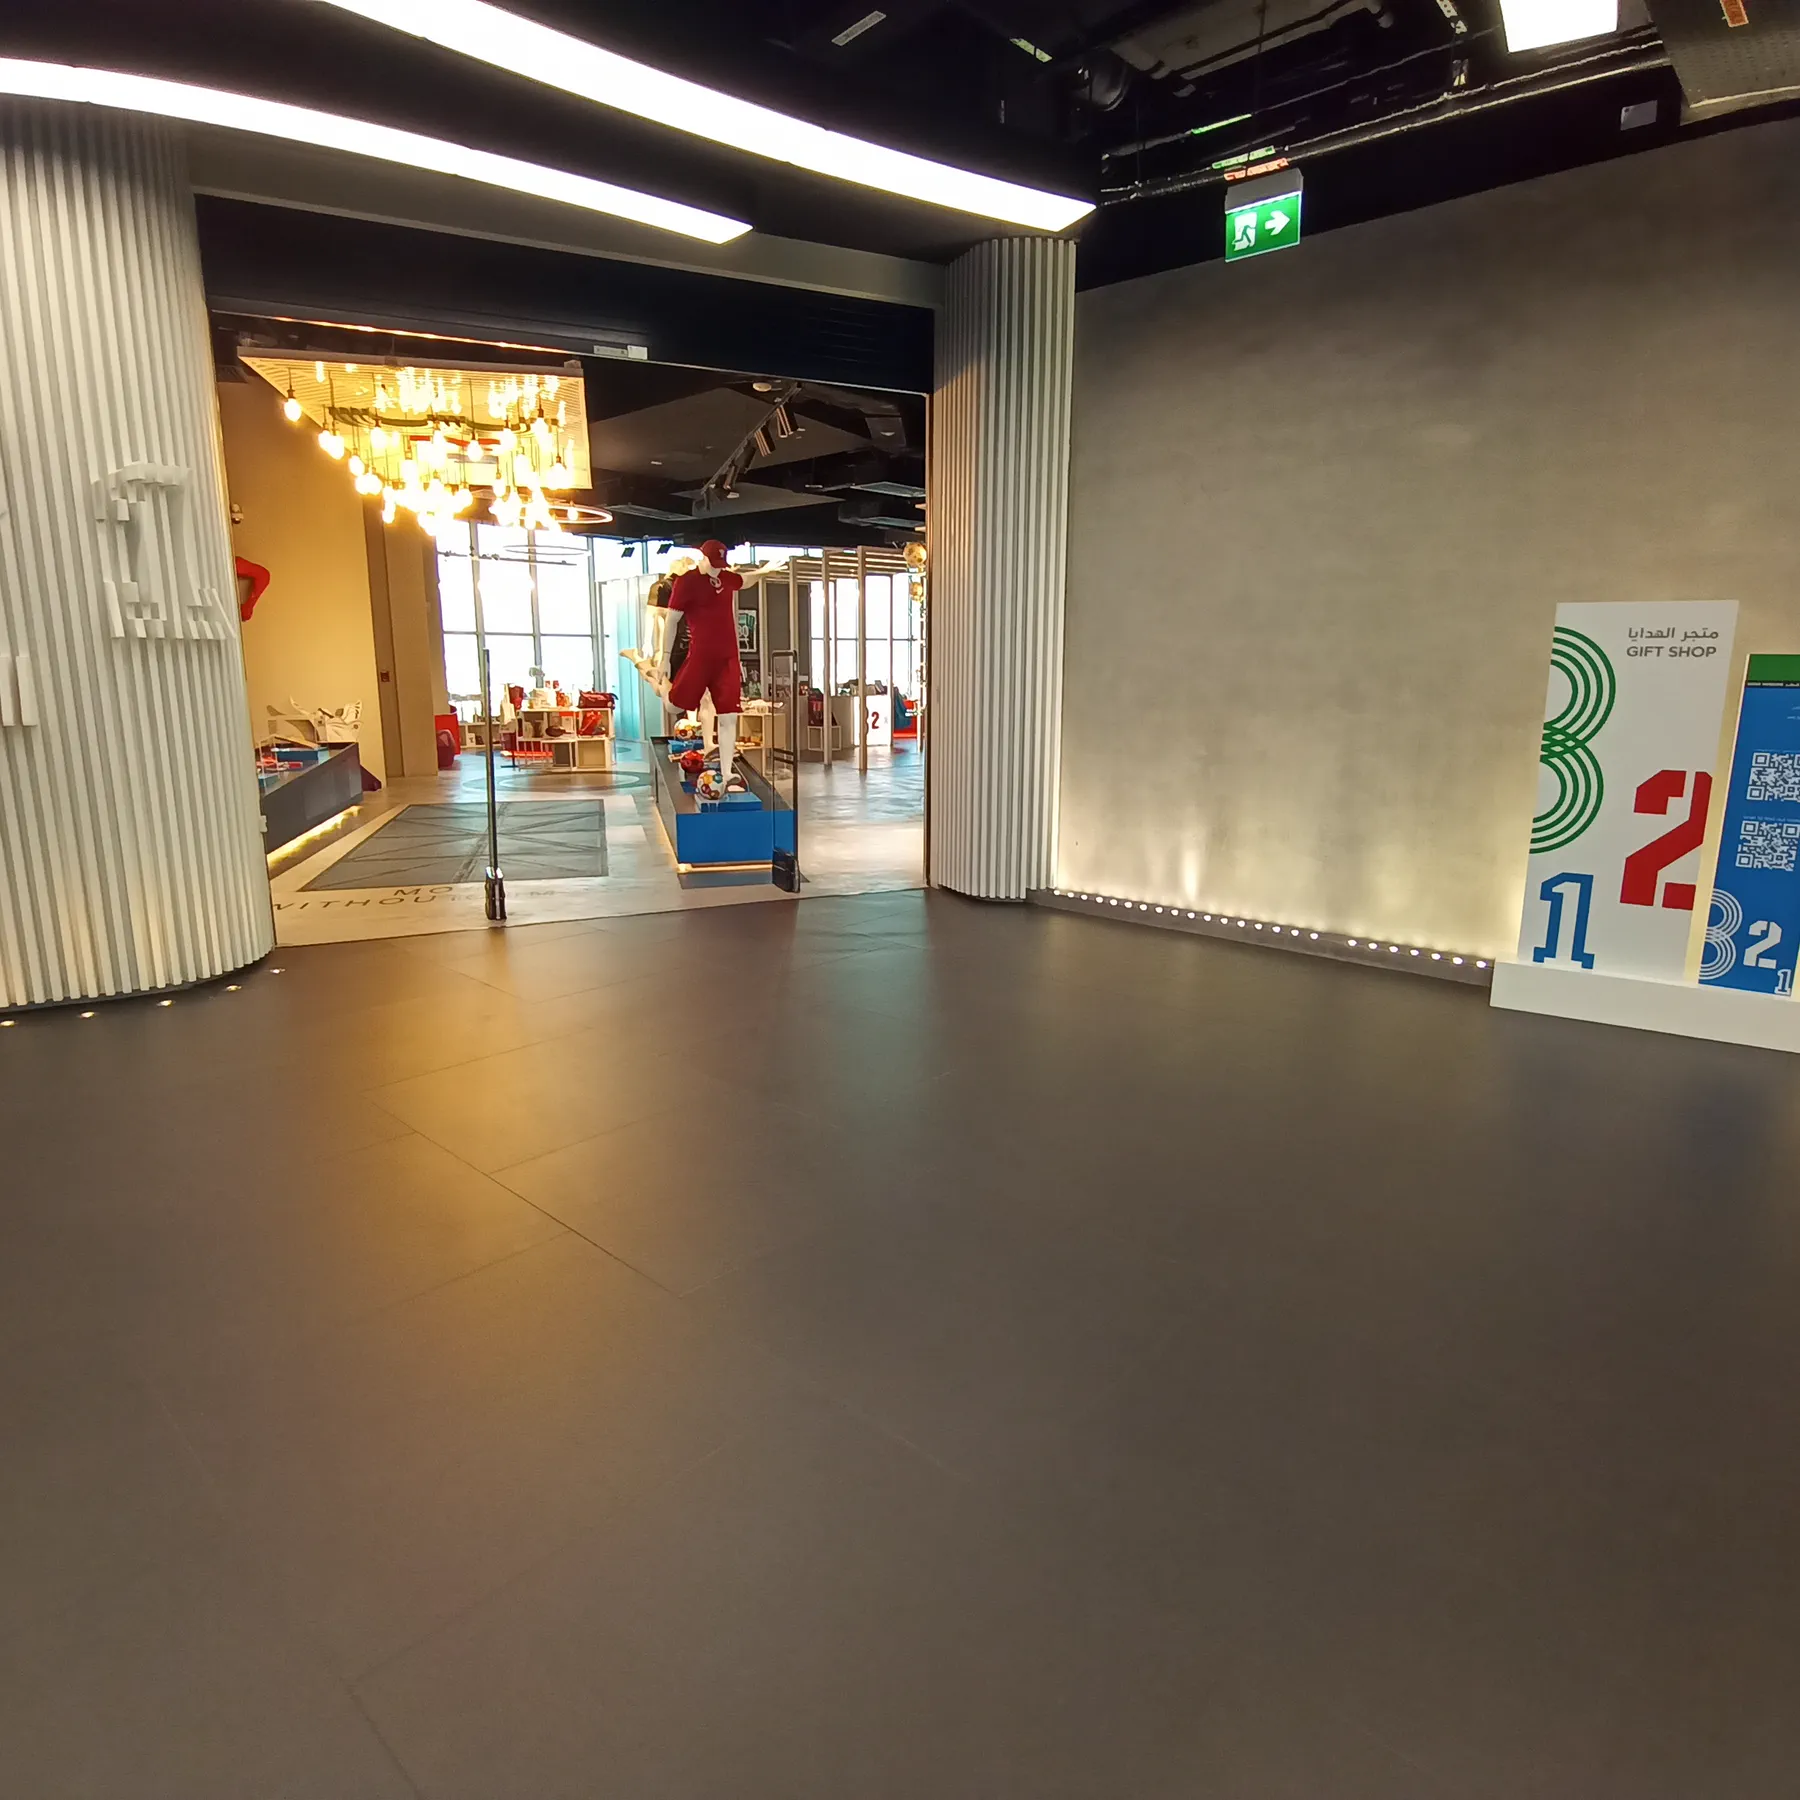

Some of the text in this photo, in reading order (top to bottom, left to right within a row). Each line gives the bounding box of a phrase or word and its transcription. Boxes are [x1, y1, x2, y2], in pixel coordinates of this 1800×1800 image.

[1626, 645, 1717, 658] GIFT SHOP
[1627, 626, 1719, 642] متجر الهدايا
[1620, 770, 1713, 911] 2
[1533, 872, 1595, 970] 1
[1743, 920, 1782, 970] 2
[1774, 968, 1792, 995] 1
